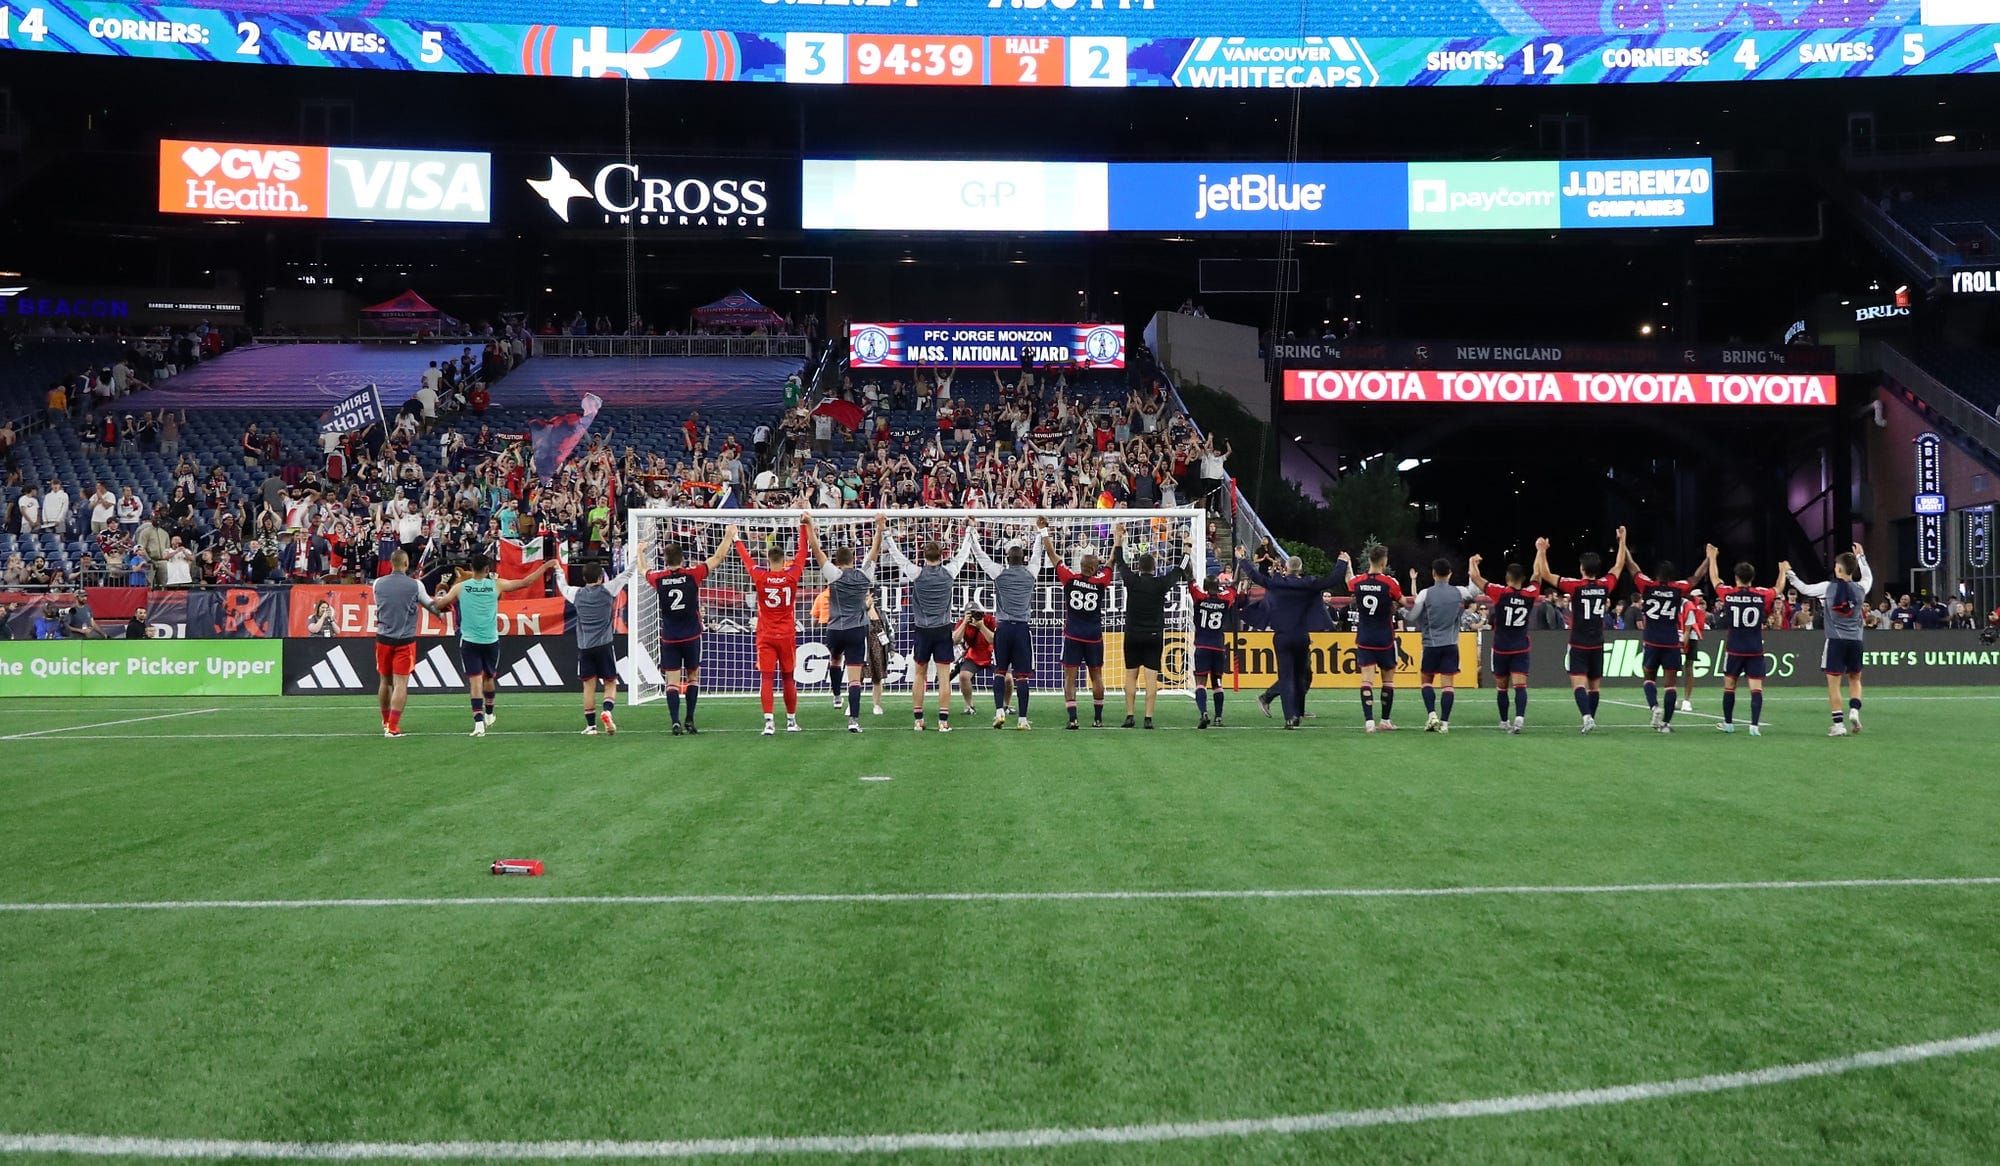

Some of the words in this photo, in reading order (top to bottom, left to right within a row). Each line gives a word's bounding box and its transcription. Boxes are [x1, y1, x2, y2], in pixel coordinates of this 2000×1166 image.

[88, 17, 209, 45] CORNERS:
[236, 22, 261, 55] 2
[307, 30, 386, 53] SAVES:
[420, 31, 444, 64] 5
[1005, 38, 1049, 55] HALF
[804, 41, 826, 76] 3
[856, 43, 974, 76] 94:39
[1222, 46, 1331, 62] VANCOUVER
[1427, 51, 1504, 71] SHOTS:
[1521, 43, 1565, 75] 12
[1602, 47, 1709, 68] CORNERS:
[1733, 39, 1759, 70] 4
[1799, 42, 1874, 63] SAVES:
[1902, 34, 1925, 66] 5
[1018, 56, 1038, 83] 2
[1088, 46, 1110, 79] 2
[1187, 66, 1362, 89] WHITECAPS
[221, 148, 301, 181] CVS
[334, 159, 485, 212] VISA
[1563, 168, 1709, 197] J.DERENZO
[185, 180, 308, 212] Health.
[1195, 174, 1326, 219] jetBlue
[1448, 186, 1554, 213] paycom
[1587, 199, 1685, 217] COMPANIES
[604, 214, 765, 226] INSURANCE
[17, 297, 128, 319] BEACON
[924, 330, 949, 341] PFC
[952, 330, 995, 342] JORGE
[998, 331, 1052, 342] MONZON
[907, 346, 948, 361] MASS.
[952, 346, 1017, 362] NATIONAL
[1275, 346, 1320, 358] BRING
[1457, 347, 1490, 360] NEW
[1494, 347, 1561, 361] ENGLAND
[1722, 349, 1766, 363] BRING
[1298, 371, 1426, 400] TOYOTA
[1437, 373, 1562, 401] TOYOTA
[1573, 374, 1696, 402] TOYOTA
[1706, 375, 1826, 403] TOYOTA
[1924, 447, 1934, 491] BEER
[1926, 517, 1936, 560] HALL
[668, 589, 685, 610] 2
[764, 586, 792, 609] 31
[1069, 590, 1099, 611] 88
[1362, 595, 1379, 615] 9
[1646, 598, 1677, 620] 24
[1199, 609, 1223, 630] 18
[1504, 606, 1528, 626] 12
[1580, 599, 1606, 620] 14
[1730, 605, 1760, 627] 10
[0, 657, 23, 675] he
[31, 657, 120, 677] Quicker
[127, 657, 199, 676] Picker
[207, 657, 275, 679] Upper
[1862, 651, 1917, 665] ETTE'S
[1925, 651, 2000, 665] ULTIMAT
